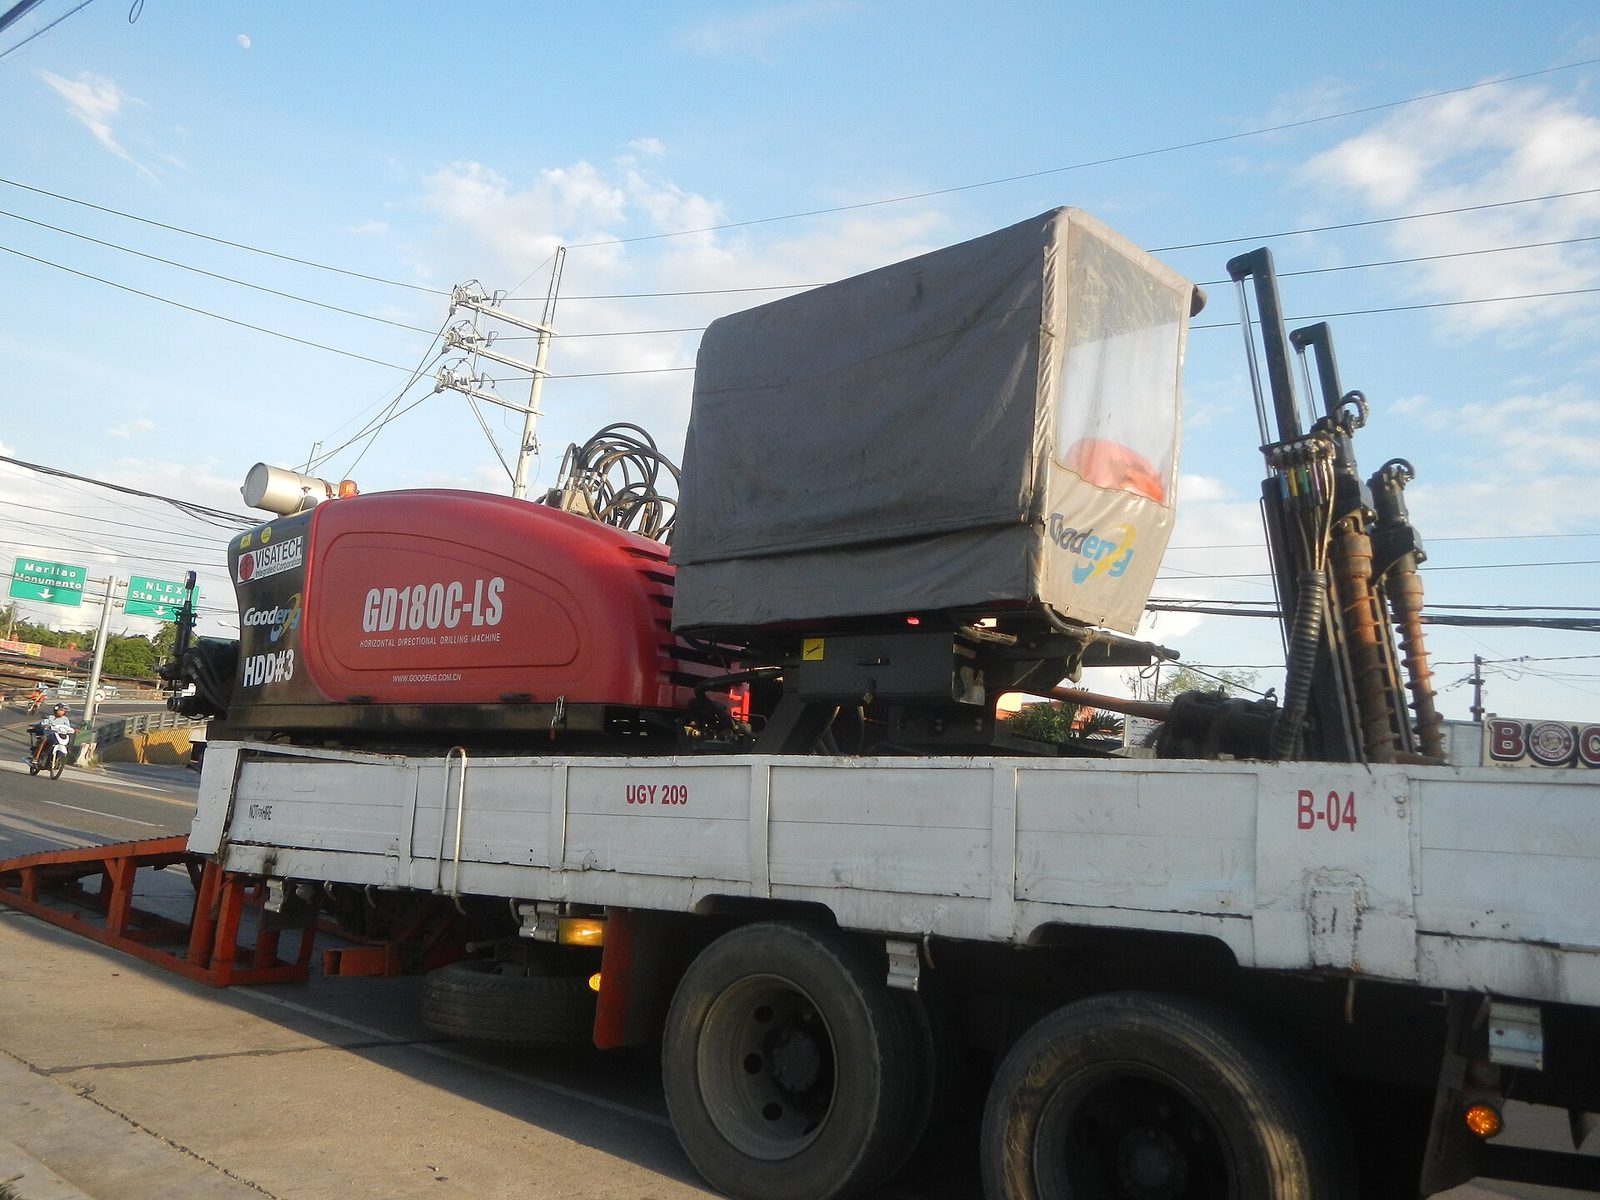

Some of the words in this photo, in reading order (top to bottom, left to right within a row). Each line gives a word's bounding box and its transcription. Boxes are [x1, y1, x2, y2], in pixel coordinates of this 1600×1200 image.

[255, 537, 303, 569] VISATECH
[24, 562, 77, 578] Marilao
[14, 572, 82, 589] Monumento
[145, 581, 184, 595] NLEX
[132, 590, 156, 602] Sta.
[159, 594, 187, 606] Mari
[362, 576, 505, 633] GD180C-LS
[359, 637, 395, 648] HORIZONTAL
[397, 636, 437, 646] DIRECTIONAL
[440, 634, 468, 644] DRILLING
[471, 632, 500, 643] MACHINE
[243, 648, 295, 687] HDD#3
[392, 673, 462, 683] WWW.GOODENG.COM.CN
[626, 784, 657, 804] UGY
[661, 784, 688, 805] 209
[1297, 789, 1357, 832] B-04
